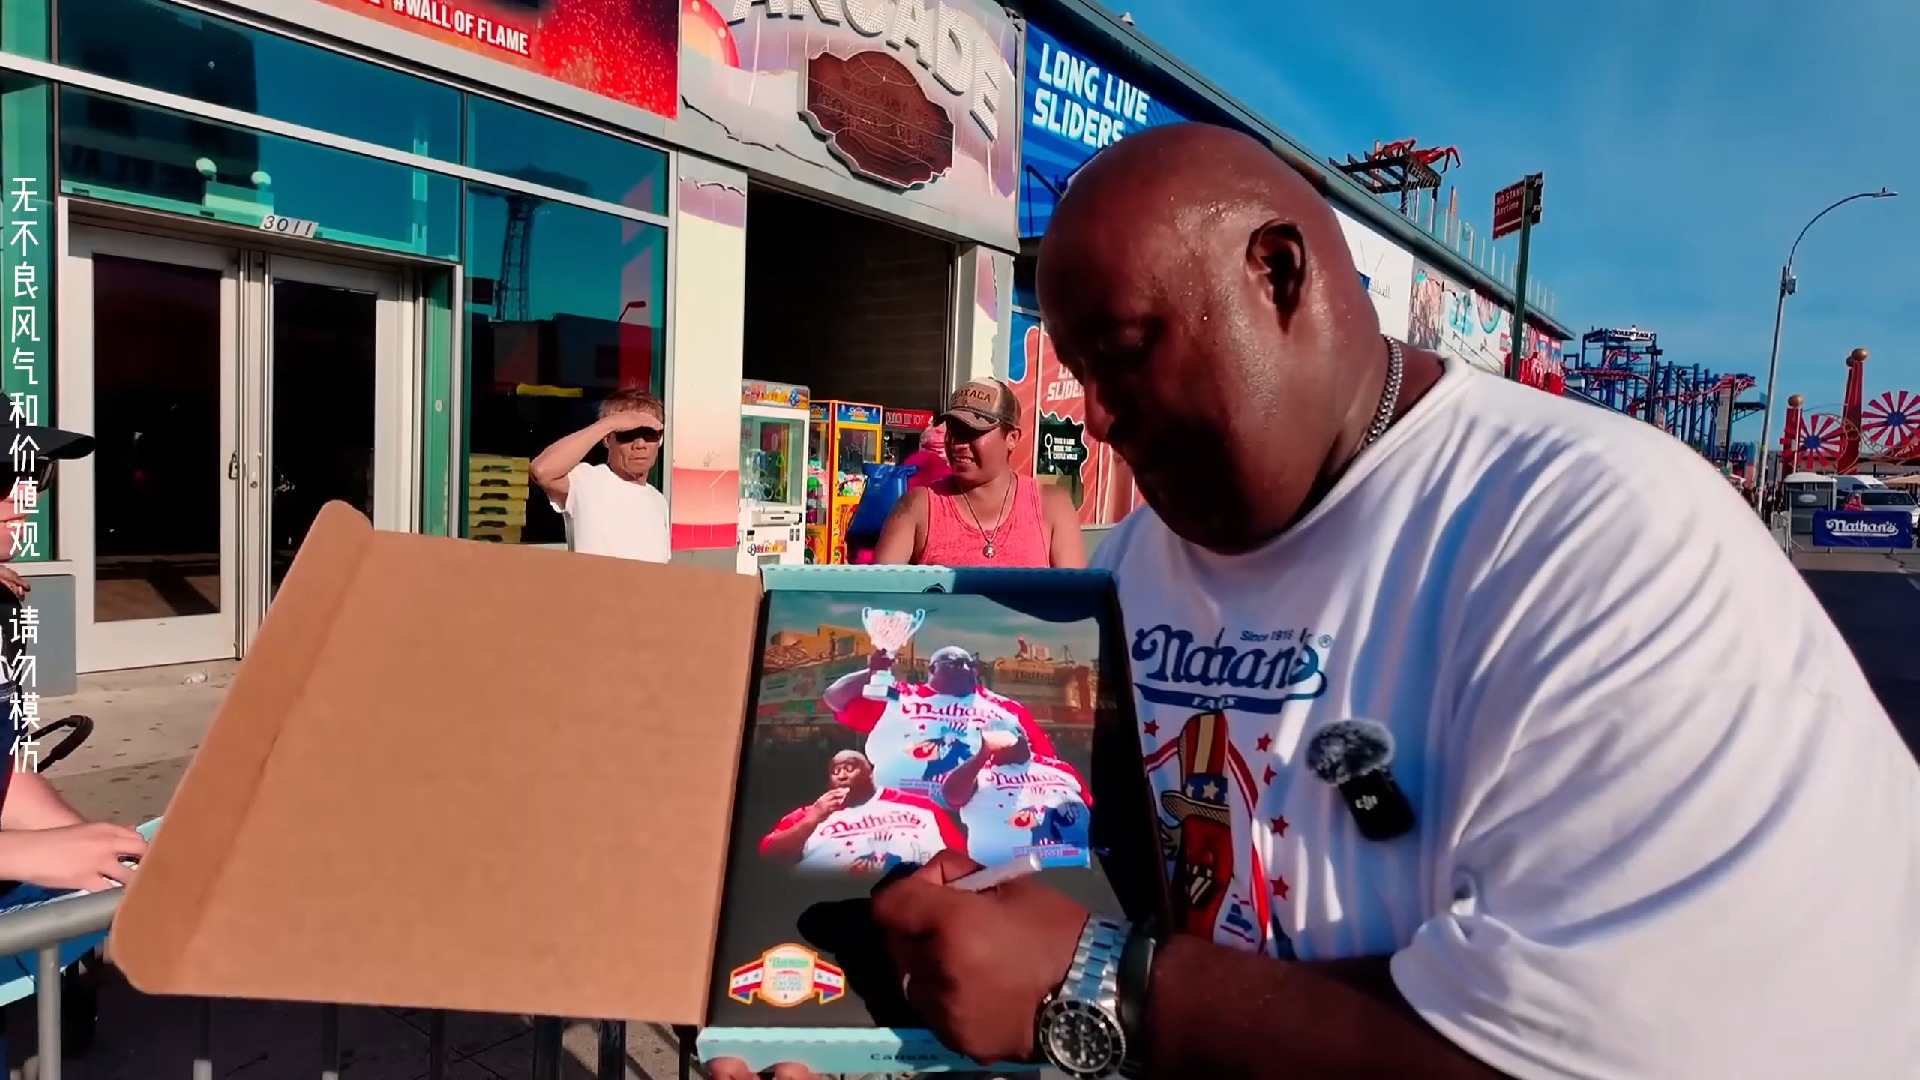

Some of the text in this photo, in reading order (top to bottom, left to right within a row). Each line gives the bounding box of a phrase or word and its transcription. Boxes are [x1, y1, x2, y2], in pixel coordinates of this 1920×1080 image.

[393, 0, 530, 55] #WALL OF FLAME
[1039, 42, 1151, 126] LONG LIVE
[263, 215, 313, 236] 3011
[1826, 518, 1900, 537] Nathan's
